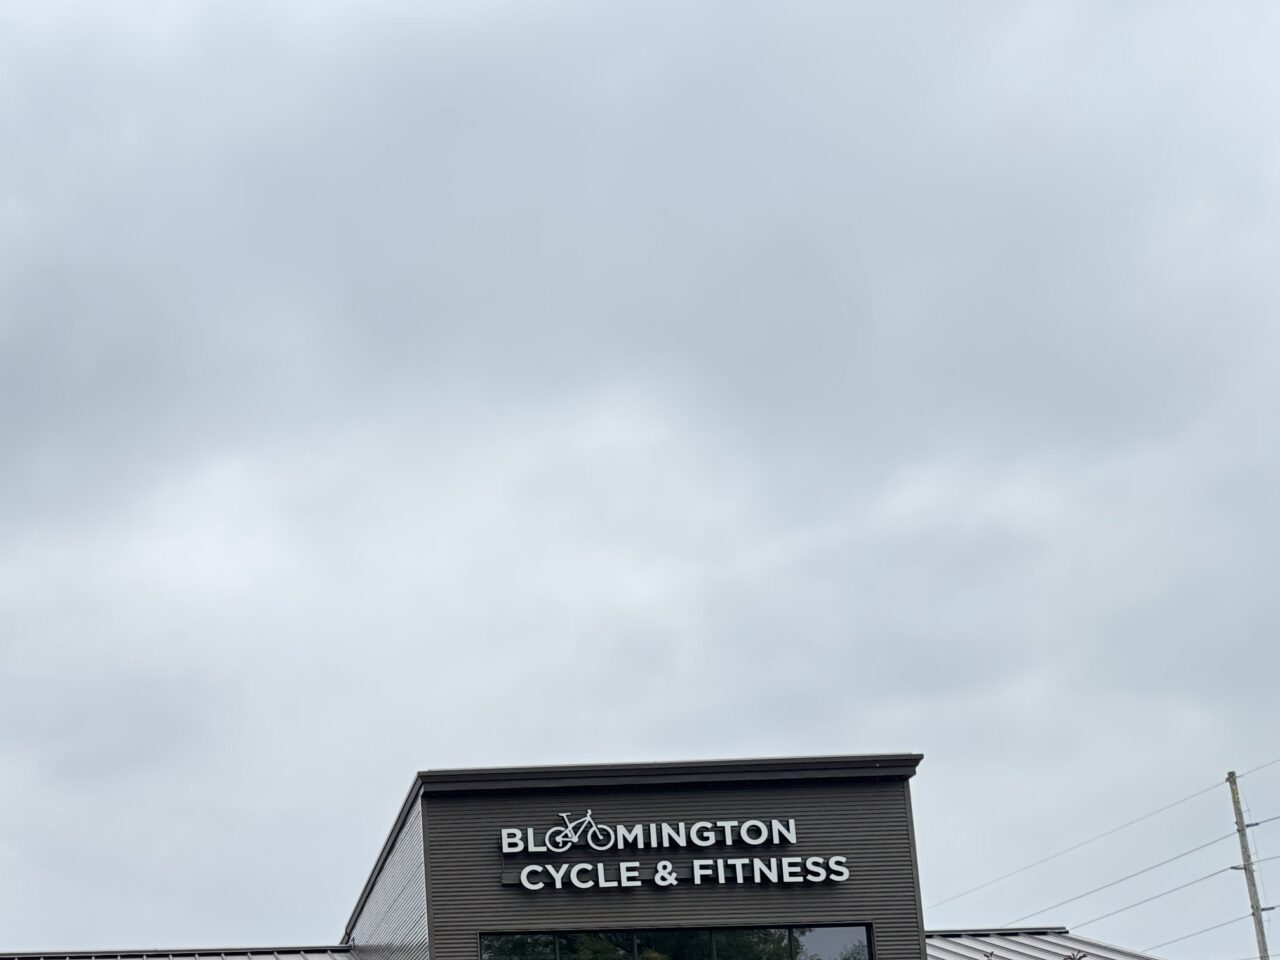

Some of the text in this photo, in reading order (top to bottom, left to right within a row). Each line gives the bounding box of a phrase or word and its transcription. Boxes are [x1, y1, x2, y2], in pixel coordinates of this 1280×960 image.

[520, 855, 850, 890] CYCLE & FITNESS
